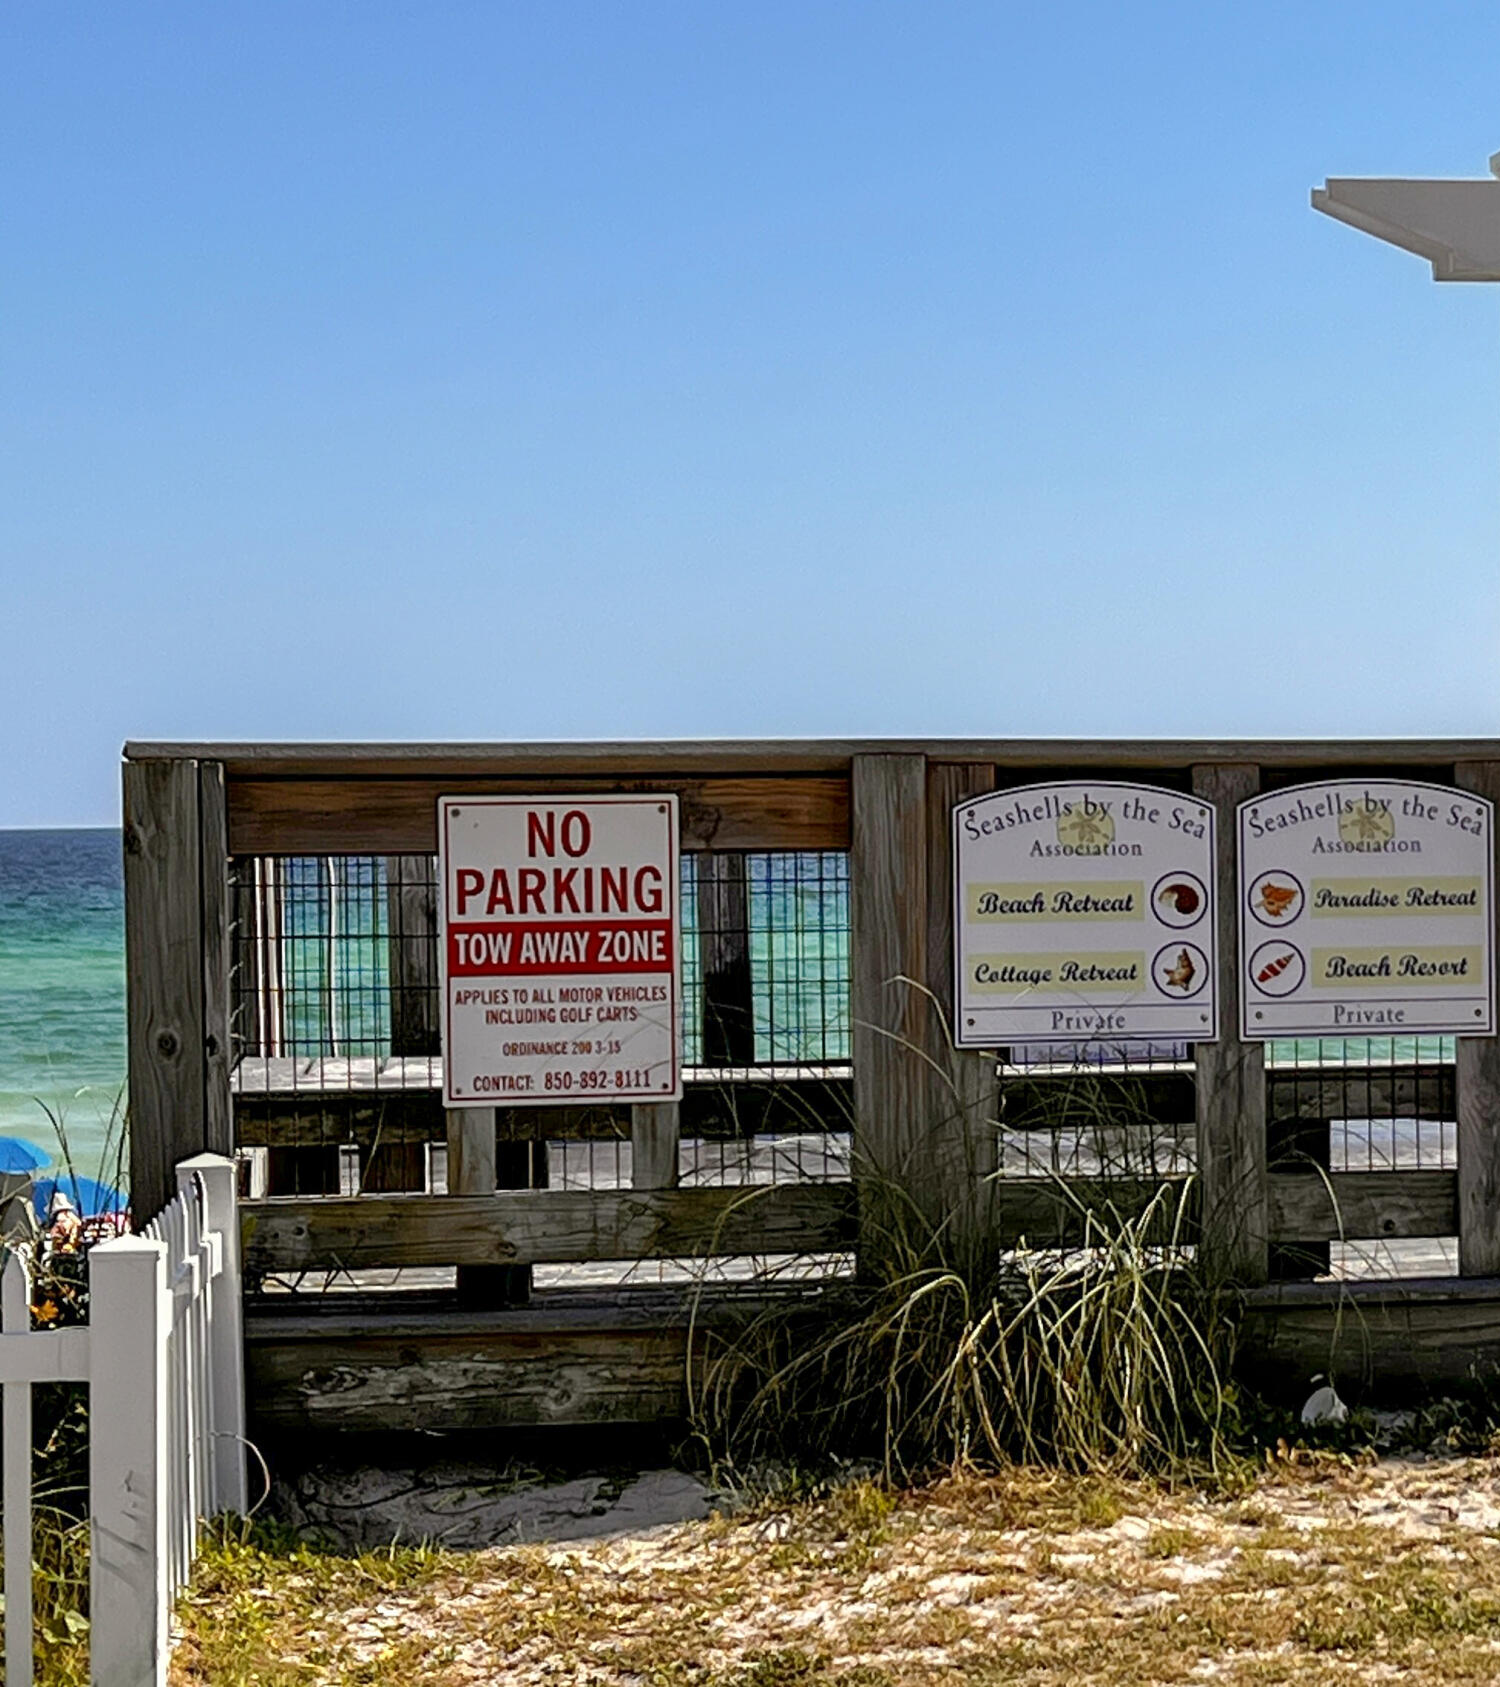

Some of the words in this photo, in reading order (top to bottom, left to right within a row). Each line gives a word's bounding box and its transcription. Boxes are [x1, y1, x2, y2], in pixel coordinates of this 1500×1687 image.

[964, 796, 1073, 841] Seashells
[1084, 793, 1112, 824] by
[1123, 797, 1160, 824] the
[1168, 808, 1206, 840] Sea
[1249, 794, 1353, 838] Seashells
[1364, 791, 1392, 818] by
[1402, 794, 1438, 821] the
[1446, 804, 1483, 837] Sea
[527, 810, 591, 858] NO
[1312, 836, 1422, 854] Association
[1030, 839, 1143, 857] Association
[456, 865, 663, 915] PARKING
[1314, 887, 1400, 908] Paradise
[1404, 886, 1477, 907] Retreat
[976, 891, 1047, 915] Beach
[1051, 891, 1135, 914] Retreat
[454, 932, 513, 965] TOW
[520, 931, 590, 964] AWAY
[598, 930, 667, 963] ZONE
[975, 963, 1052, 986] Cottage
[1059, 961, 1138, 982] Retreat
[1325, 955, 1392, 978] Beach
[1396, 954, 1468, 976] Resort
[455, 989, 509, 1006] APPLIES
[512, 988, 528, 1004] TO
[532, 988, 555, 1004] ALL
[559, 987, 604, 1003] MOTOR
[607, 985, 668, 1002] VEHICLES
[485, 1007, 556, 1024] INCLUDING
[560, 1006, 593, 1023] GOLF
[597, 1005, 638, 1023] CARTS
[1051, 1010, 1126, 1031] Private
[1334, 1005, 1405, 1024] Private
[502, 1041, 568, 1057] ORDINANCE
[473, 1075, 534, 1092] CONTACT:
[544, 1070, 651, 1091] 850-892-8111
